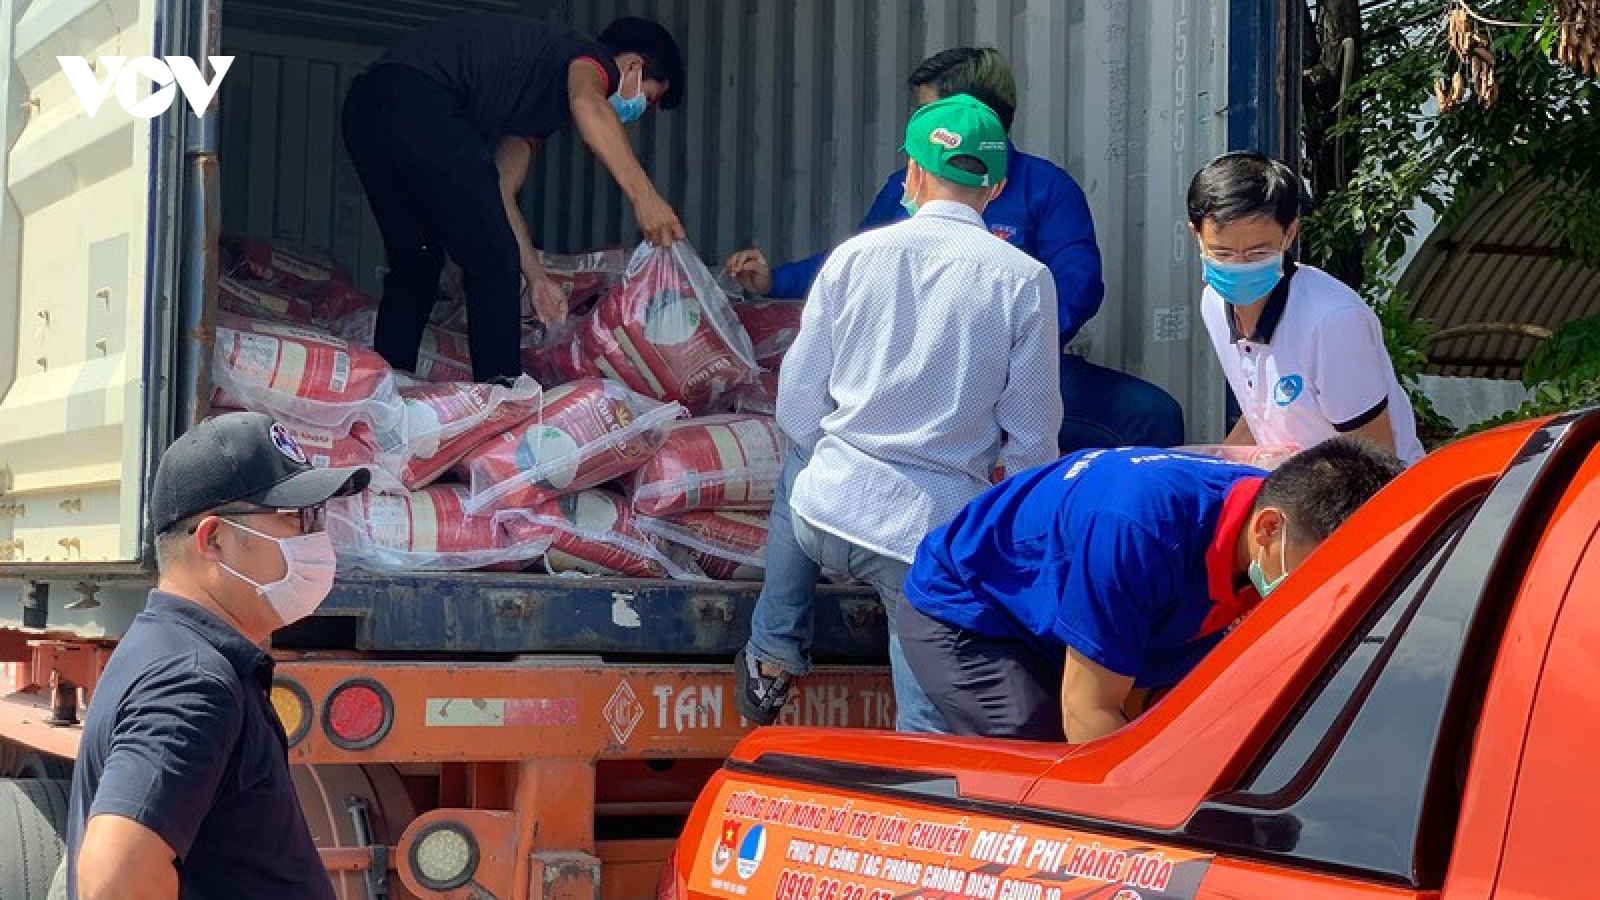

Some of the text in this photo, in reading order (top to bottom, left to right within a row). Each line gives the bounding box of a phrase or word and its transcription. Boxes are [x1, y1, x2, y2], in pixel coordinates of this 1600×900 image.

[652, 684, 722, 733] TAN
[859, 691, 896, 727] TR
[1026, 838, 1072, 873] PHÍ
